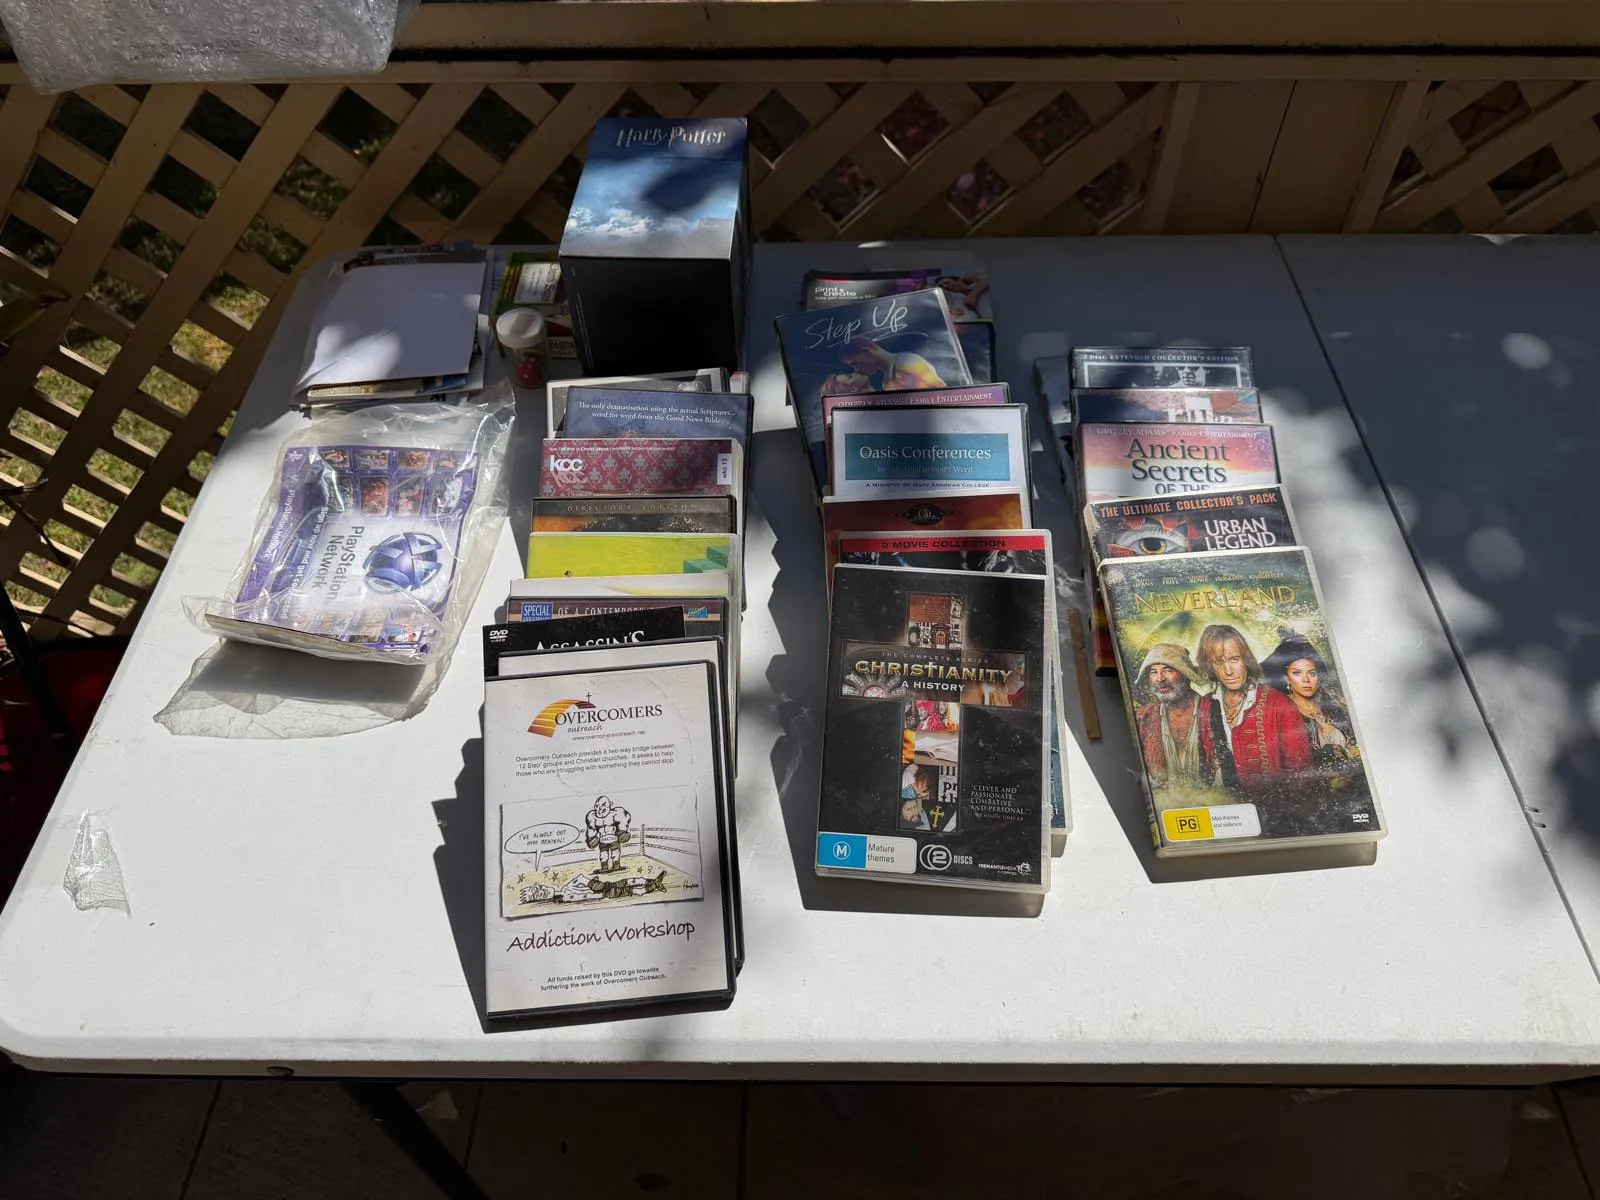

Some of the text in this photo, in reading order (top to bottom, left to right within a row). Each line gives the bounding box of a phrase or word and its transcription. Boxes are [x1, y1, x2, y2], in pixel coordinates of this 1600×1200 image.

[616, 126, 726, 148] Harry Potter
[805, 299, 908, 349] Step Up
[577, 401, 590, 409] The
[591, 402, 606, 410] only
[650, 406, 667, 414] using
[666, 414, 684, 422] Good
[686, 415, 703, 423] News
[860, 445, 992, 461] Oasis Conferences
[1127, 438, 1230, 461] Ancient
[1132, 459, 1227, 483] Secrets
[1155, 483, 1177, 494] OF
[1100, 493, 1278, 518] THE ULTIMATE COLLECTOR'S PACK
[1204, 517, 1267, 537] URBAN
[933, 540, 1006, 548] COLLECTION
[1204, 532, 1277, 551] LEGEND
[312, 535, 345, 589] Network
[329, 526, 365, 600] PlayStation
[1133, 586, 1297, 614] NEVERLAND
[523, 604, 550, 616] SPECIAL
[557, 607, 569, 616] OF
[575, 607, 580, 616] A
[489, 629, 509, 637] DVD
[855, 660, 1014, 683] CHRISTIANITY
[901, 680, 965, 692] A HISTORY
[555, 704, 663, 725] OVERCOMERS
[567, 723, 603, 733] outreach
[516, 754, 550, 762] Overcomers
[543, 760, 563, 768] groups
[556, 765, 585, 773] struggling
[598, 762, 628, 770] something
[1179, 819, 1197, 831] PG
[836, 844, 847, 857] M
[867, 843, 895, 854] Mature
[867, 854, 895, 863] themes
[953, 855, 974, 865] DISCS
[506, 920, 696, 952] Addiction Workshop
[540, 983, 569, 991] furthering
